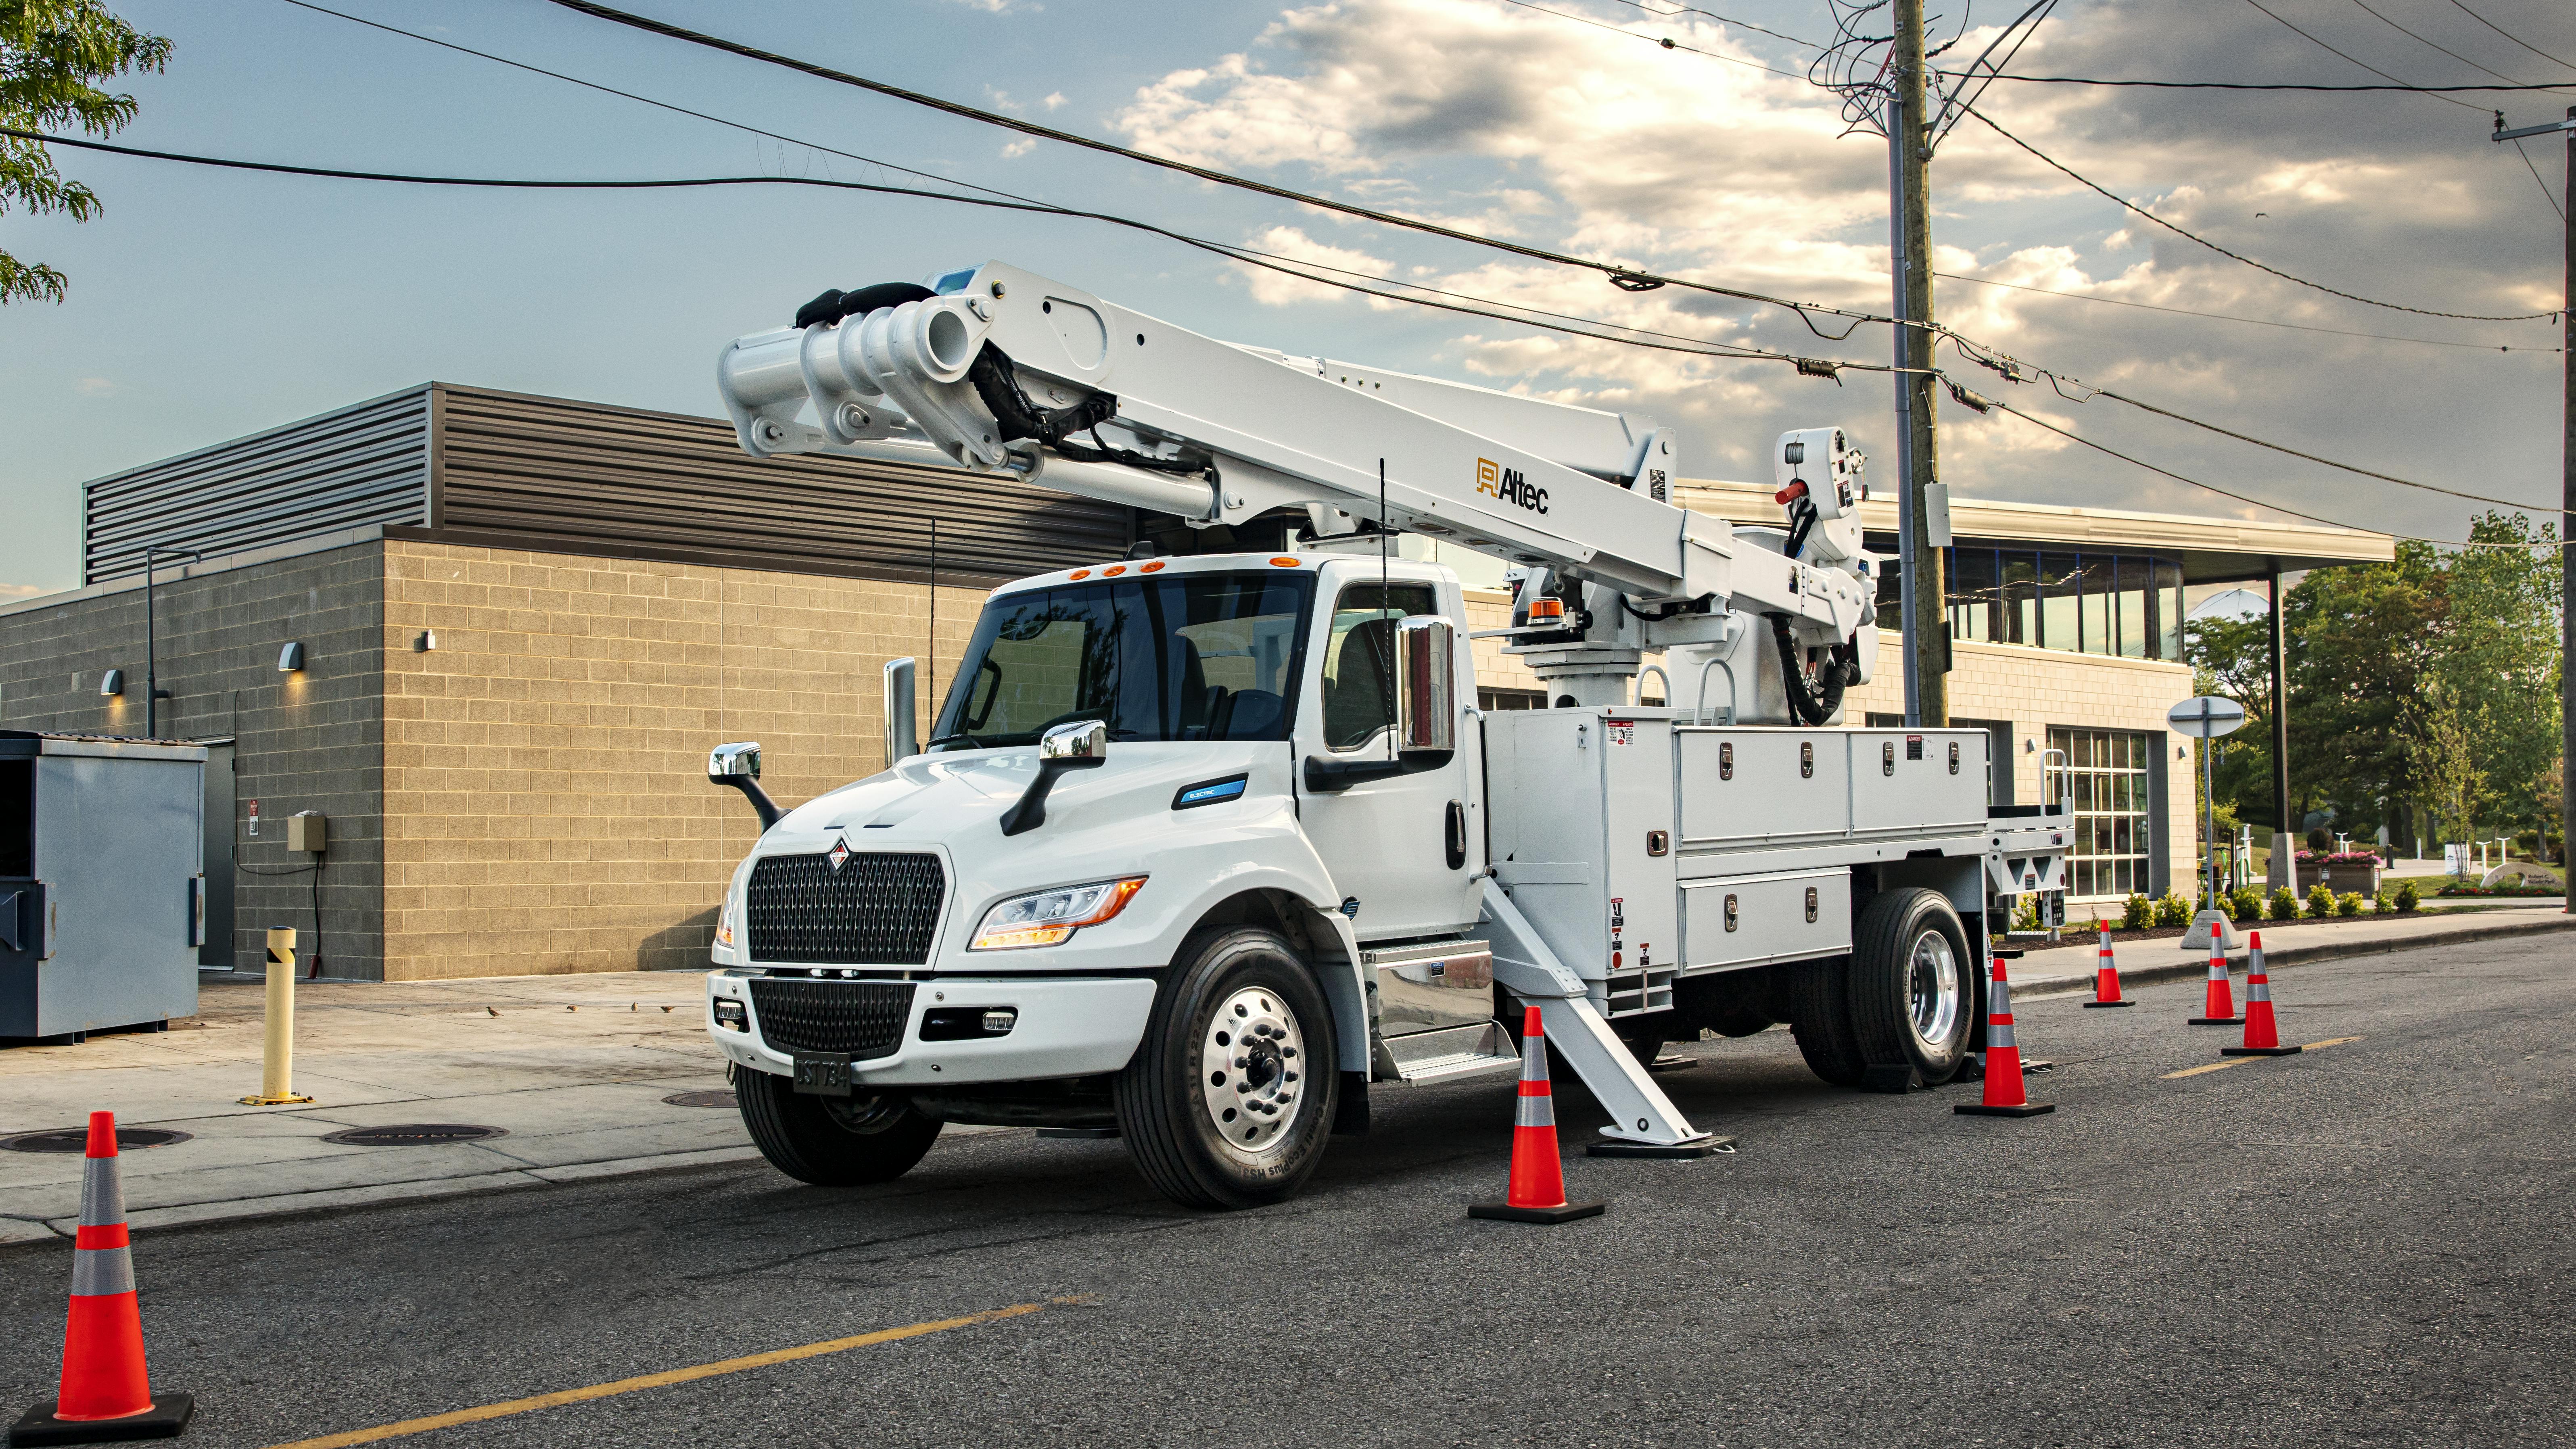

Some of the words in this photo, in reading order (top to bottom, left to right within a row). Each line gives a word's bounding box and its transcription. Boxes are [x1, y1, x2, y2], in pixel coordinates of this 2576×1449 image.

[1498, 468, 1549, 515] Altec
[1189, 790, 1215, 798] ELECTRIC
[1268, 1144, 1306, 1175] EcoPlus
